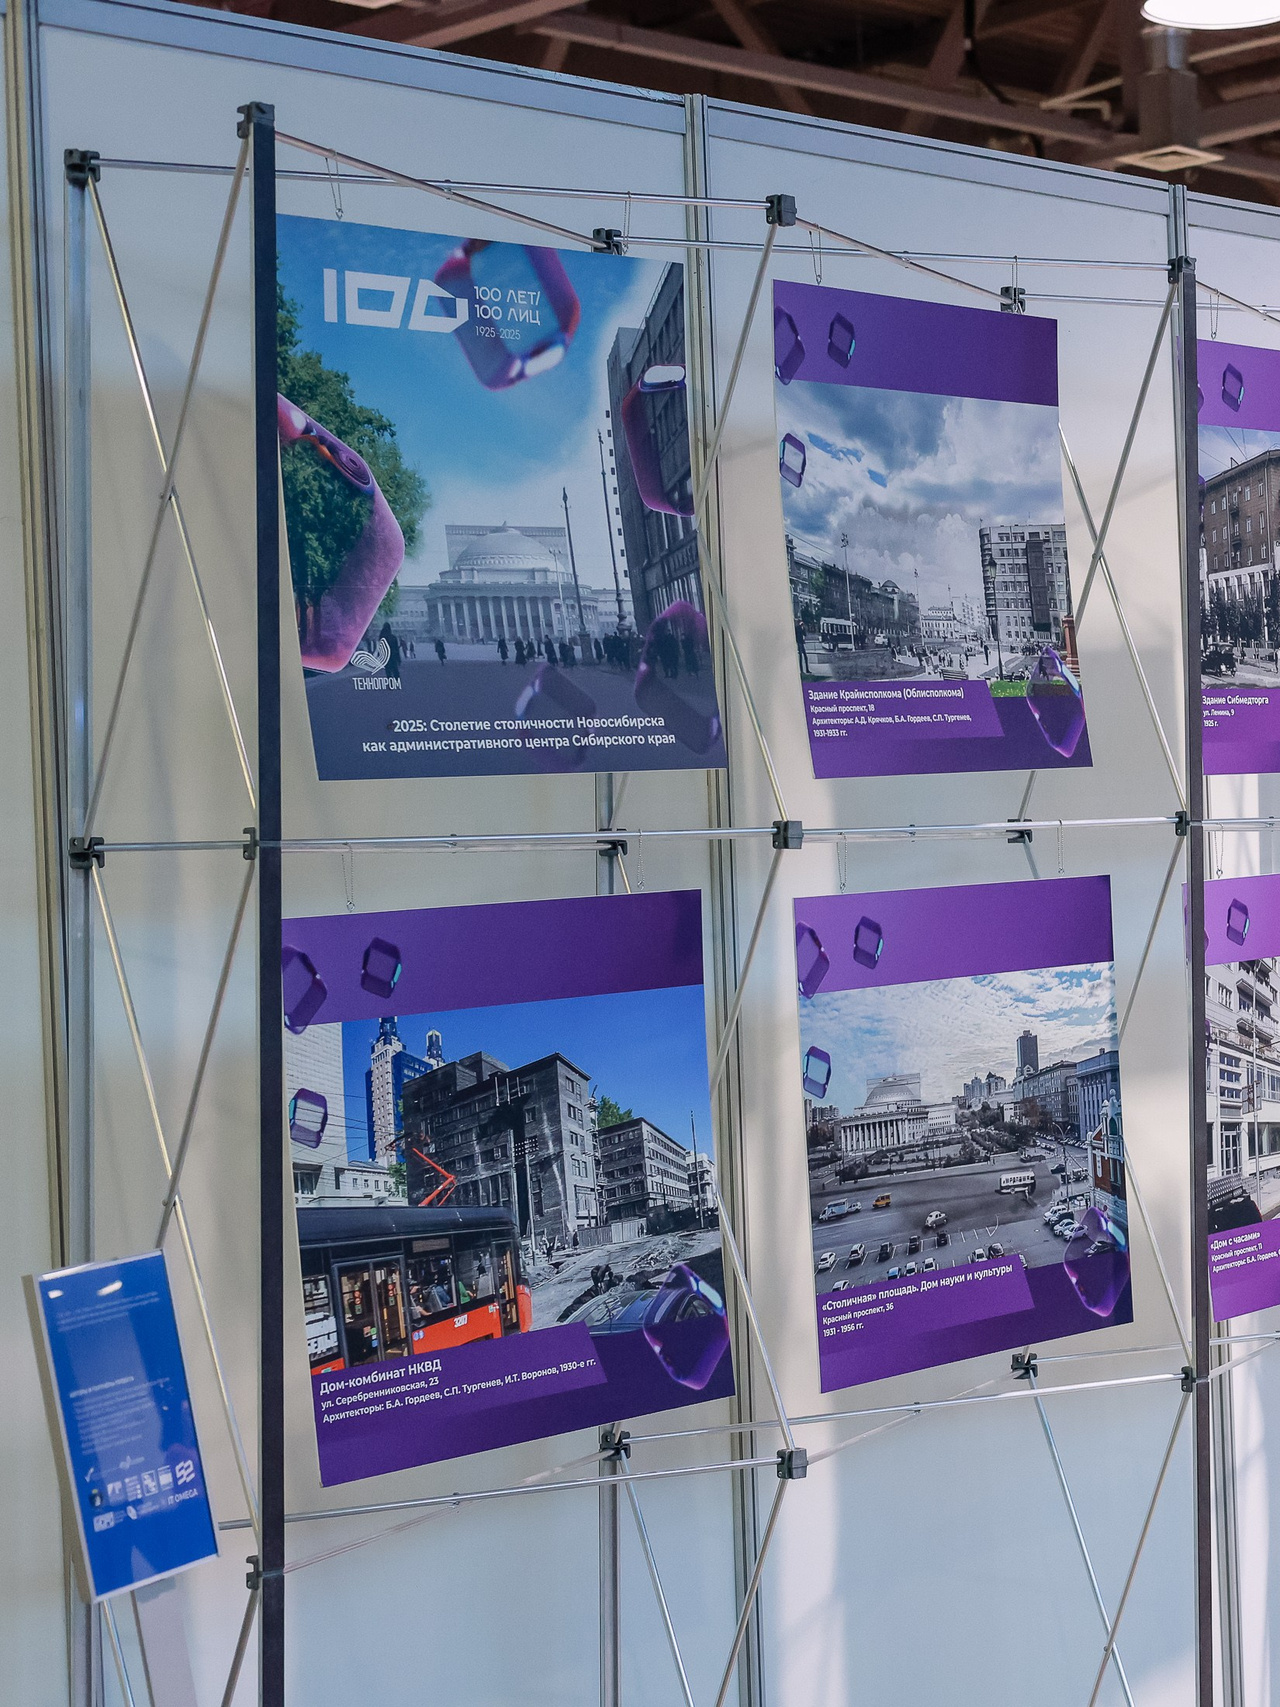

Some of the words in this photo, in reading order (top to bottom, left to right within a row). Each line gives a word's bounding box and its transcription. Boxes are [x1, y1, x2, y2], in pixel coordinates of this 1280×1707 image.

[474, 286, 502, 302] 100
[506, 290, 541, 306] ЛЕТ/
[475, 304, 502, 321] 100
[507, 308, 541, 326] ЛИЦ
[475, 326, 521, 340] 1925-2025
[808, 690, 838, 700] Здание
[839, 689, 902, 701] Крайисполкома
[903, 688, 964, 699] (Облисполкома)
[1202, 696, 1226, 705] Здание
[1227, 695, 1269, 705] Сибмедторга
[810, 705, 837, 714] Красный
[838, 704, 868, 713] проспект,
[392, 720, 428, 733] 2025:
[430, 719, 491, 731] Столетие
[493, 717, 574, 731] столичности
[577, 714, 665, 730] Новосибирска
[812, 718, 854, 726] Архитекторы:
[868, 716, 894, 725] Крячков,
[908, 715, 932, 723] Гордеев,
[945, 714, 972, 722] Тургенев,
[813, 729, 839, 737] 1931-1933
[362, 741, 387, 752] как
[389, 737, 522, 753] административного
[525, 736, 570, 749] центра
[572, 733, 645, 748] Сибирского
[648, 734, 676, 746] края
[1210, 1240, 1227, 1250] «Дом
[1233, 1232, 1261, 1244] часами»
[1211, 1250, 1234, 1262] Красный
[1234, 1245, 1258, 1256] проспект,
[822, 1294, 877, 1310] «Столичная»
[879, 1285, 919, 1299] площадь.
[920, 1280, 939, 1292] Дом
[941, 1275, 965, 1286] науки
[974, 1265, 1013, 1280] культуры
[822, 1312, 852, 1325] Красный
[853, 1306, 885, 1318] проспект,
[823, 1328, 836, 1336] 1931
[840, 1323, 855, 1332] 1956
[319, 1368, 405, 1395] Дом-комбинат
[408, 1359, 442, 1375] НКВД
[320, 1401, 334, 1411] ул.
[335, 1381, 427, 1405] Серебренниковская,
[428, 1377, 439, 1386] 23
[322, 1404, 384, 1423] Архитекторы:
[385, 1399, 403, 1409] Б.А.
[404, 1392, 442, 1405] Гордеев,
[443, 1386, 461, 1396] С.П.
[461, 1379, 503, 1394] Тургенев,
[504, 1374, 520, 1383] И.Т.
[521, 1367, 558, 1380] Воронов,
[559, 1362, 584, 1371] 1930-е
[175, 1488, 199, 1502] OMEGA
